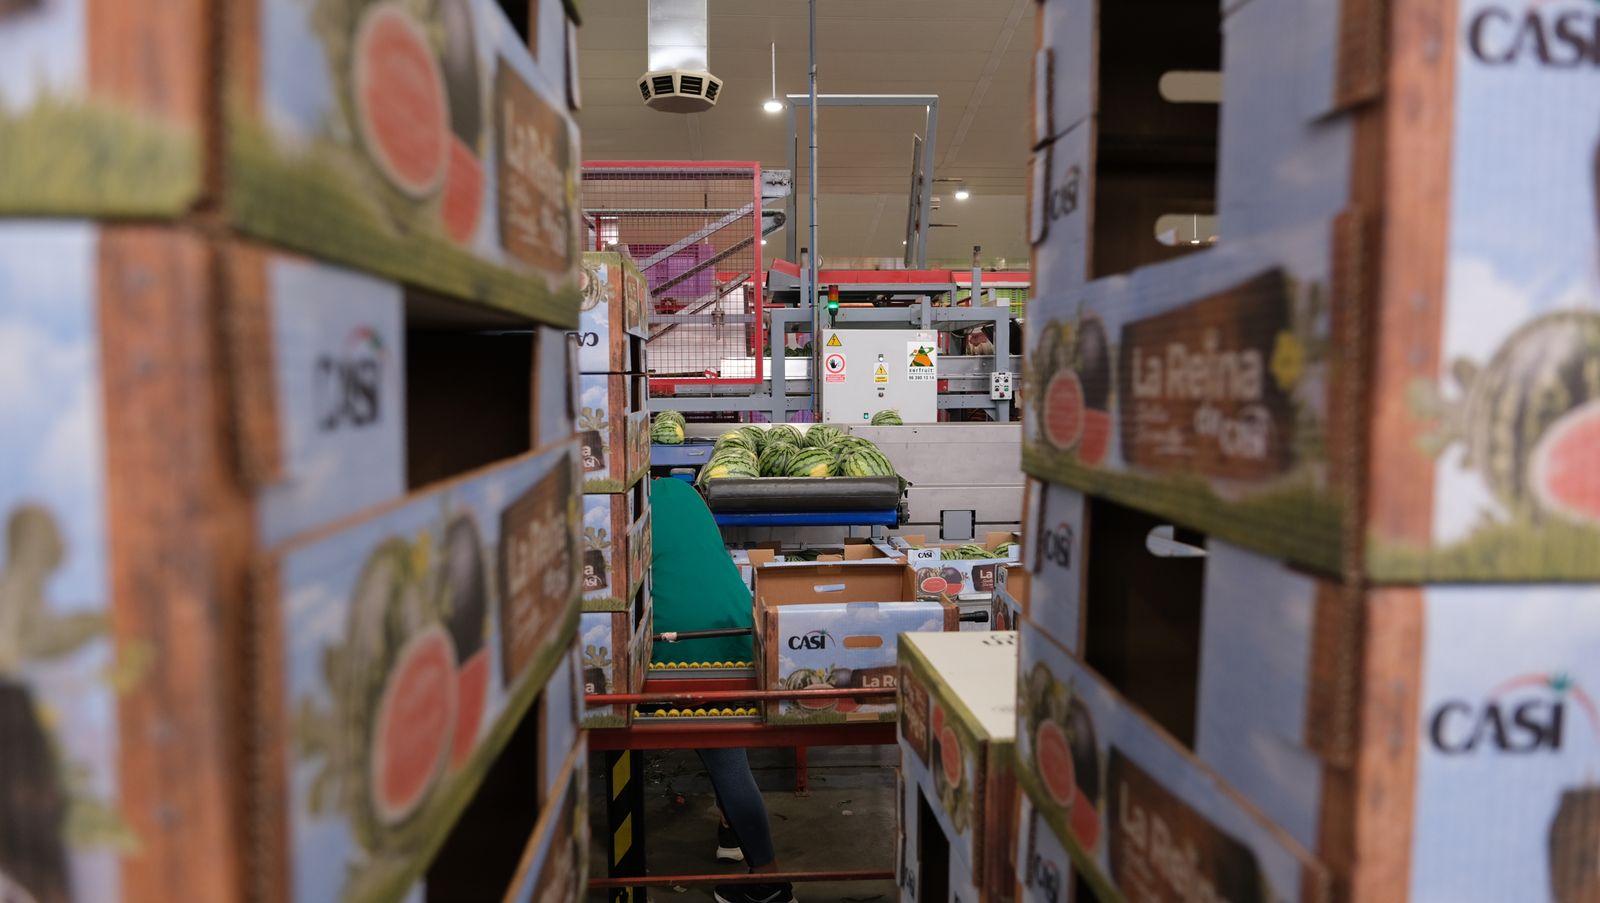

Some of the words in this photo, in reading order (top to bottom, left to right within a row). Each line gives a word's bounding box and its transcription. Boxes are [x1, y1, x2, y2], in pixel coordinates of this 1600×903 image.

[1468, 6, 1600, 68] CASI
[1131, 344, 1163, 398] La
[1165, 328, 1263, 400] Reina
[918, 551, 933, 559] CASI
[980, 570, 993, 579] La
[788, 635, 826, 650] CASI
[862, 676, 880, 687] La
[1430, 697, 1563, 754] CASI
